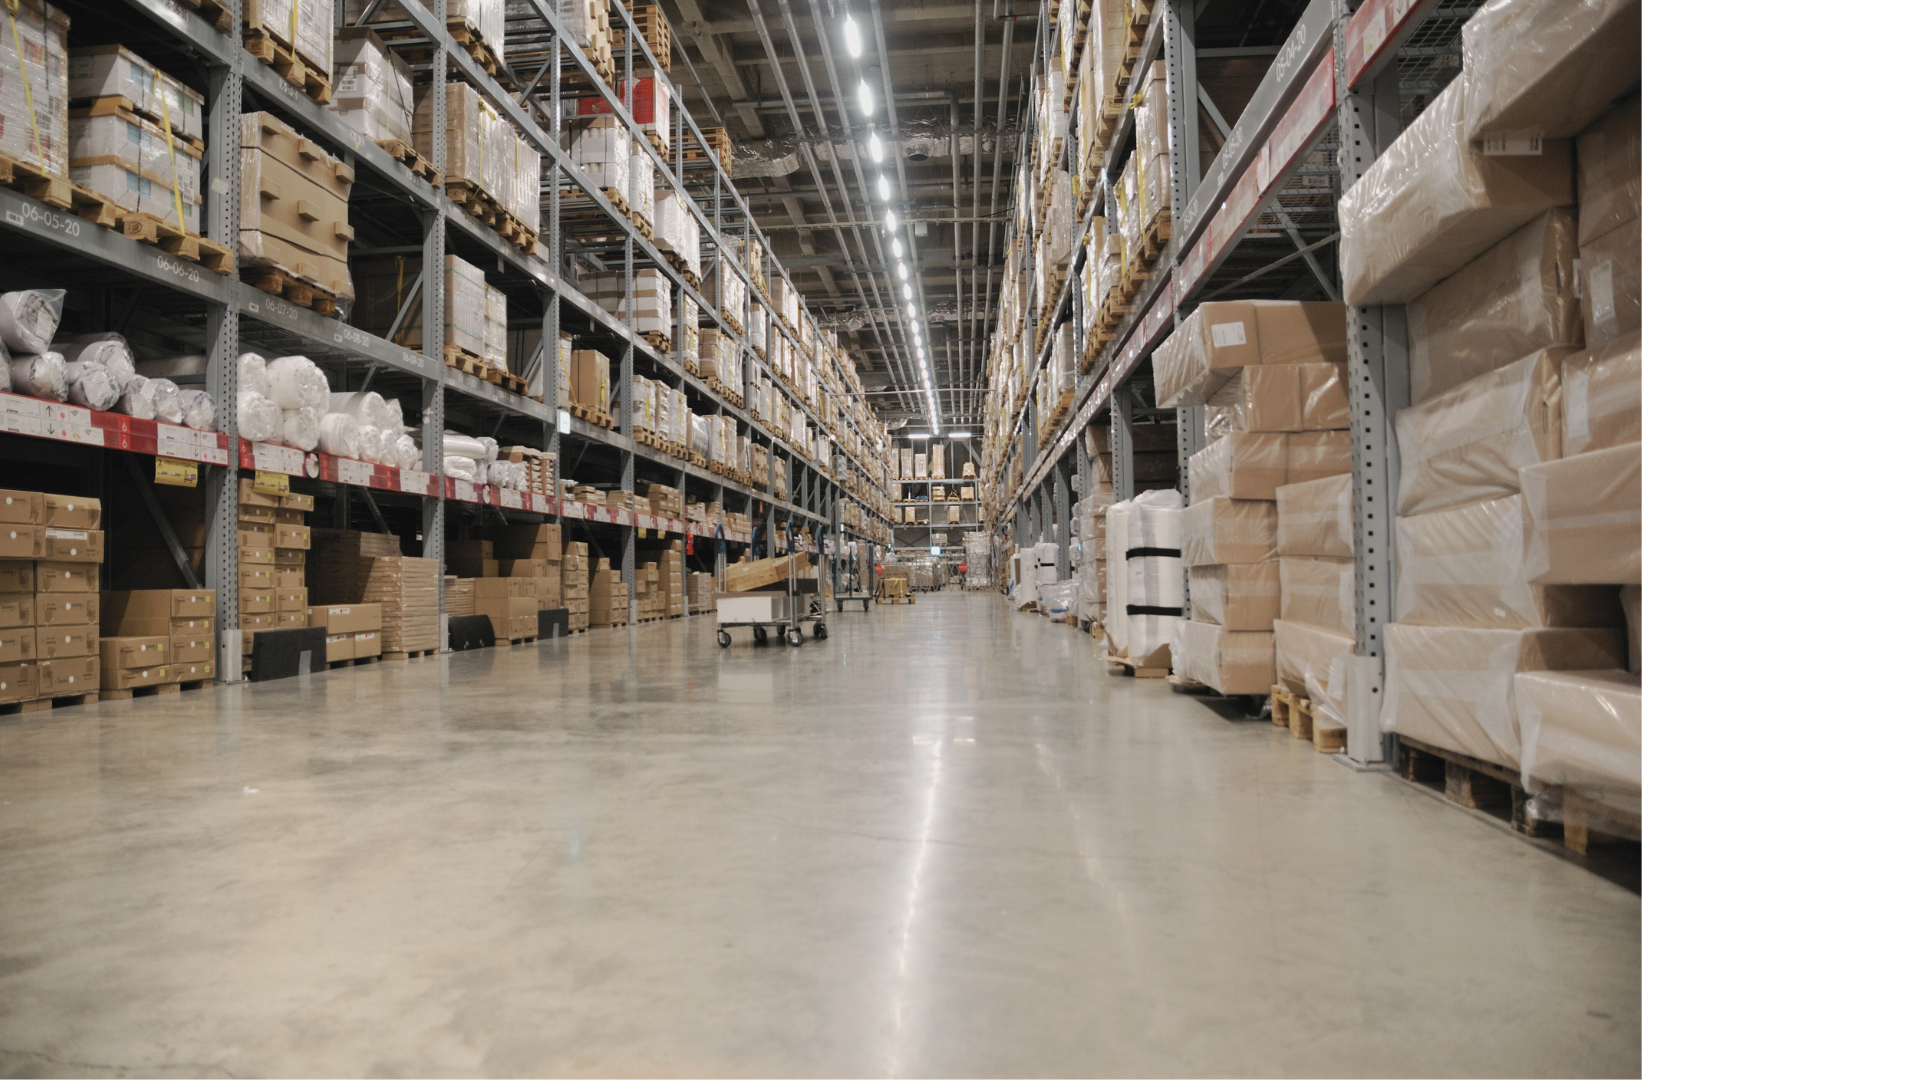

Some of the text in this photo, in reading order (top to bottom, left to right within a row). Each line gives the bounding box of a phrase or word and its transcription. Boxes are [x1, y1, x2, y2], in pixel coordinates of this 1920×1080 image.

[1276, 24, 1306, 82] 05-04-20
[22, 202, 80, 237] 06-05-20
[157, 255, 200, 282] 06-06-20
[265, 298, 298, 320] 06-07-20
[343, 329, 370, 347] 06-08-20
[121, 422, 128, 432] 6
[122, 440, 128, 449] 6
